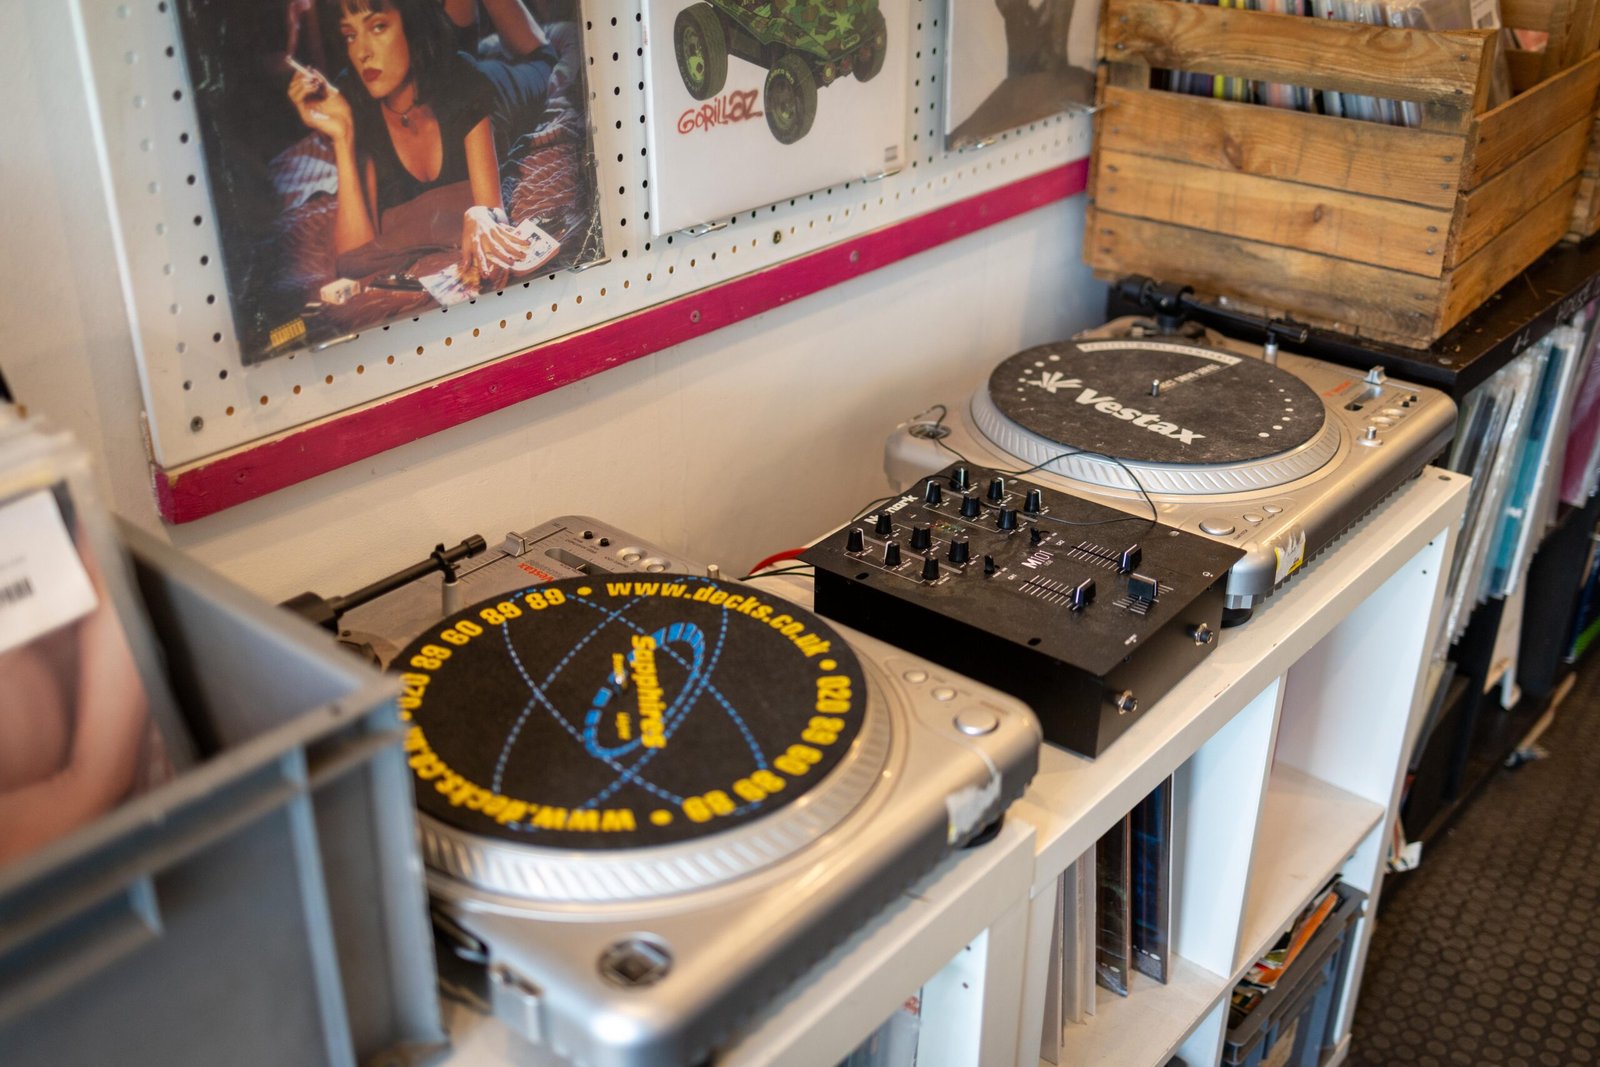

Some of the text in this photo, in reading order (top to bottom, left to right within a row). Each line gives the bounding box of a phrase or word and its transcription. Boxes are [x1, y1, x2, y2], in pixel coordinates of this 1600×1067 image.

[1075, 388, 1206, 445] Vestax
[864, 495, 918, 524] Nmark
[1022, 550, 1054, 569] M101
[479, 602, 522, 625] 89
[525, 588, 566, 610] 89
[606, 582, 831, 657] www.decks.co.uk
